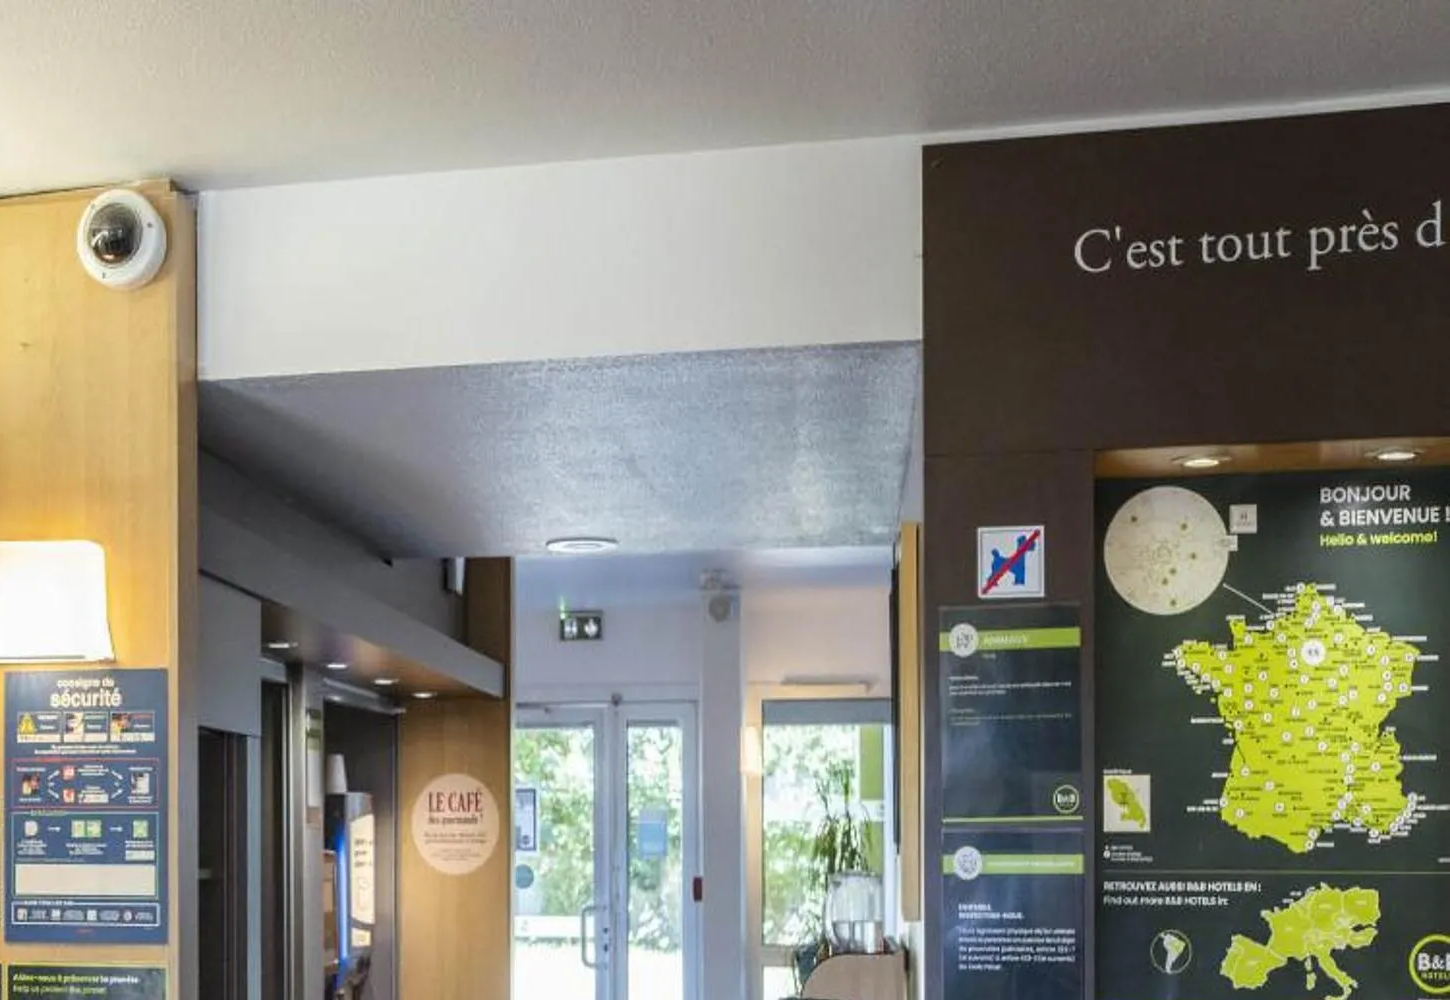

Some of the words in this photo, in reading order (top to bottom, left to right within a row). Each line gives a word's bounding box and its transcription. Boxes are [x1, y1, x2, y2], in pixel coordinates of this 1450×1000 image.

[1074, 225, 1185, 274] C'est
[1200, 226, 1293, 264] tout
[1306, 208, 1399, 272] près
[1416, 200, 1447, 249] d
[1319, 484, 1412, 504] BONJOUR
[1319, 510, 1335, 527] &
[1338, 506, 1441, 527] BIENVENUE
[1319, 533, 1355, 547] Hello
[1356, 532, 1368, 546] &
[1370, 530, 1438, 545] welcome!
[57, 678, 101, 690] consigne
[102, 676, 115, 688] de
[50, 686, 123, 708] sécurité
[428, 791, 445, 813] LE
[448, 787, 484, 813] CAFÉ
[1103, 881, 1157, 893] RETROUVEZ
[1158, 881, 1185, 892] AUSSI
[1186, 881, 1207, 892] B&B
[1208, 881, 1243, 893] HOTELS
[1103, 895, 1122, 906] Find
[1122, 896, 1138, 906] out
[1140, 896, 1164, 907] more
[1165, 896, 1182, 906] B&B
[1184, 896, 1217, 906] HOTELS
